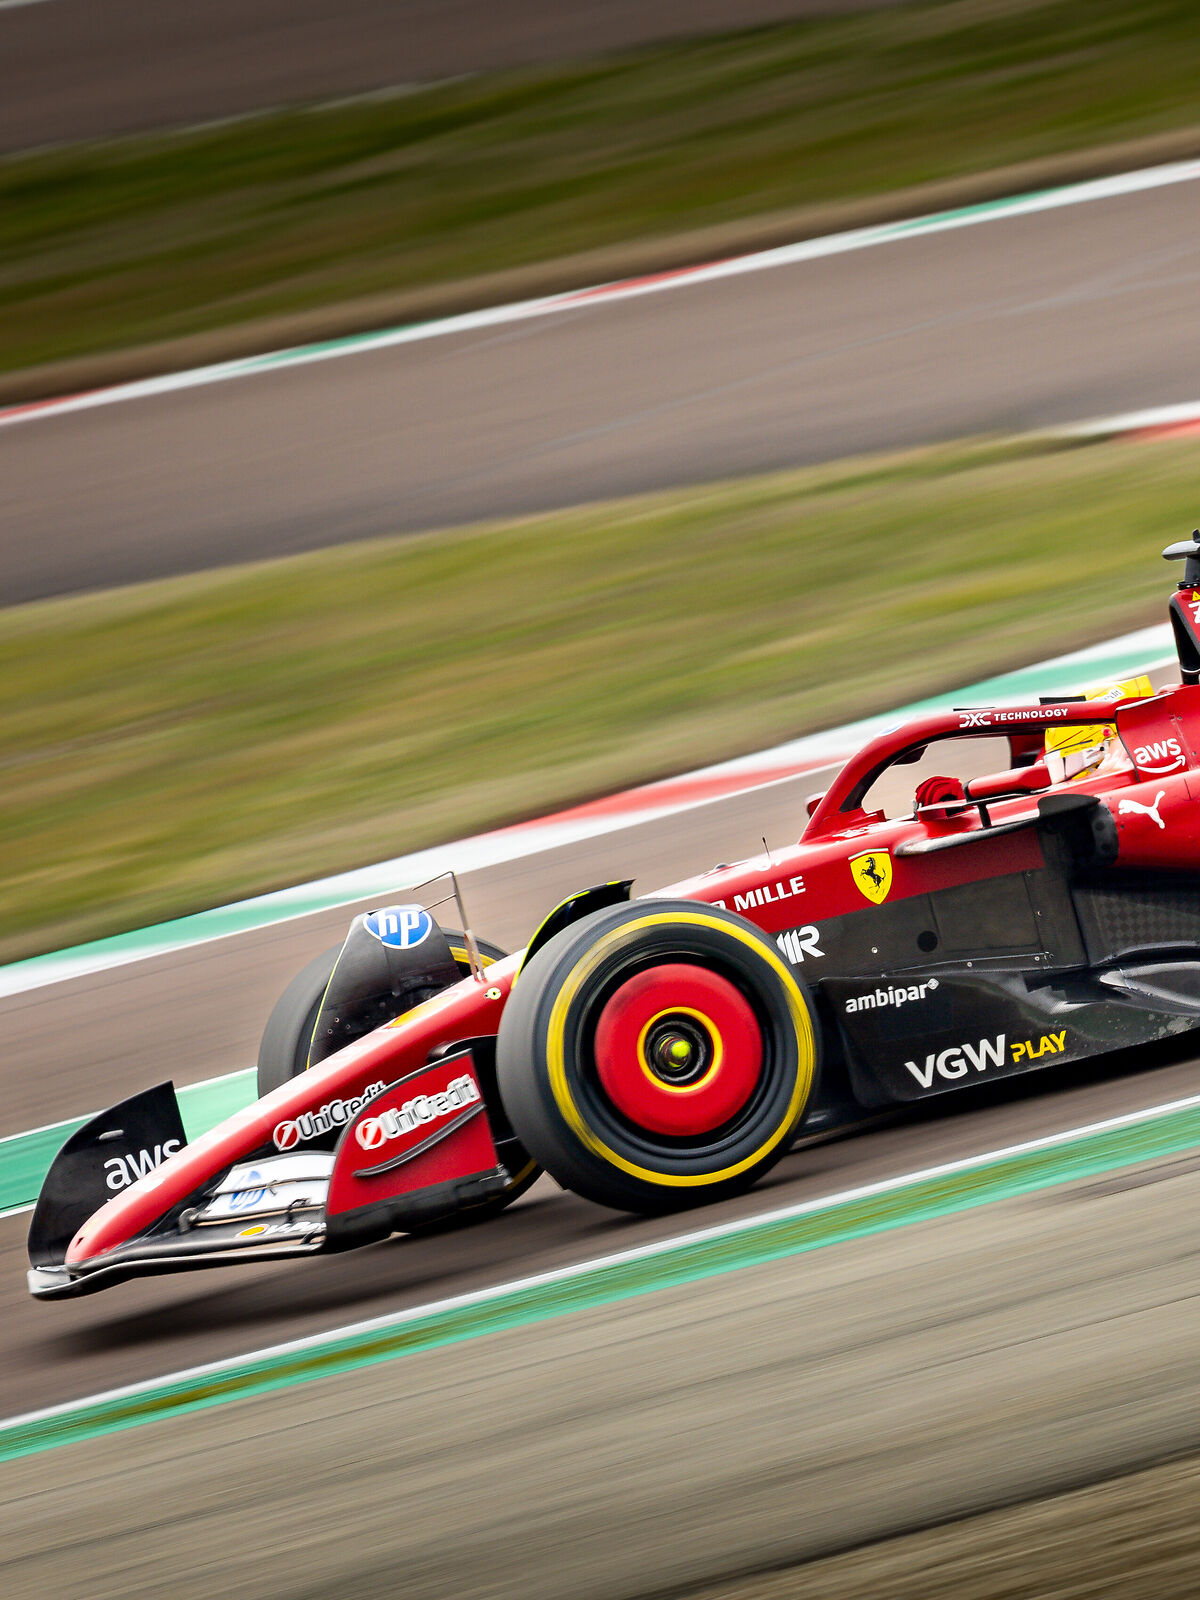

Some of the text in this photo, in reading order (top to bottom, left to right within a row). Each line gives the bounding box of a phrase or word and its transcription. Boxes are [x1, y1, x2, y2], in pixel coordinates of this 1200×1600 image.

[994, 708, 1068, 721] TECHNOLOGY
[1133, 737, 1182, 765] aws
[734, 876, 806, 912] MILLE
[378, 909, 420, 947] hp
[845, 983, 928, 1014] ambipar
[904, 1030, 1067, 1089] VGW PLAY
[382, 1075, 480, 1138] UniCredit
